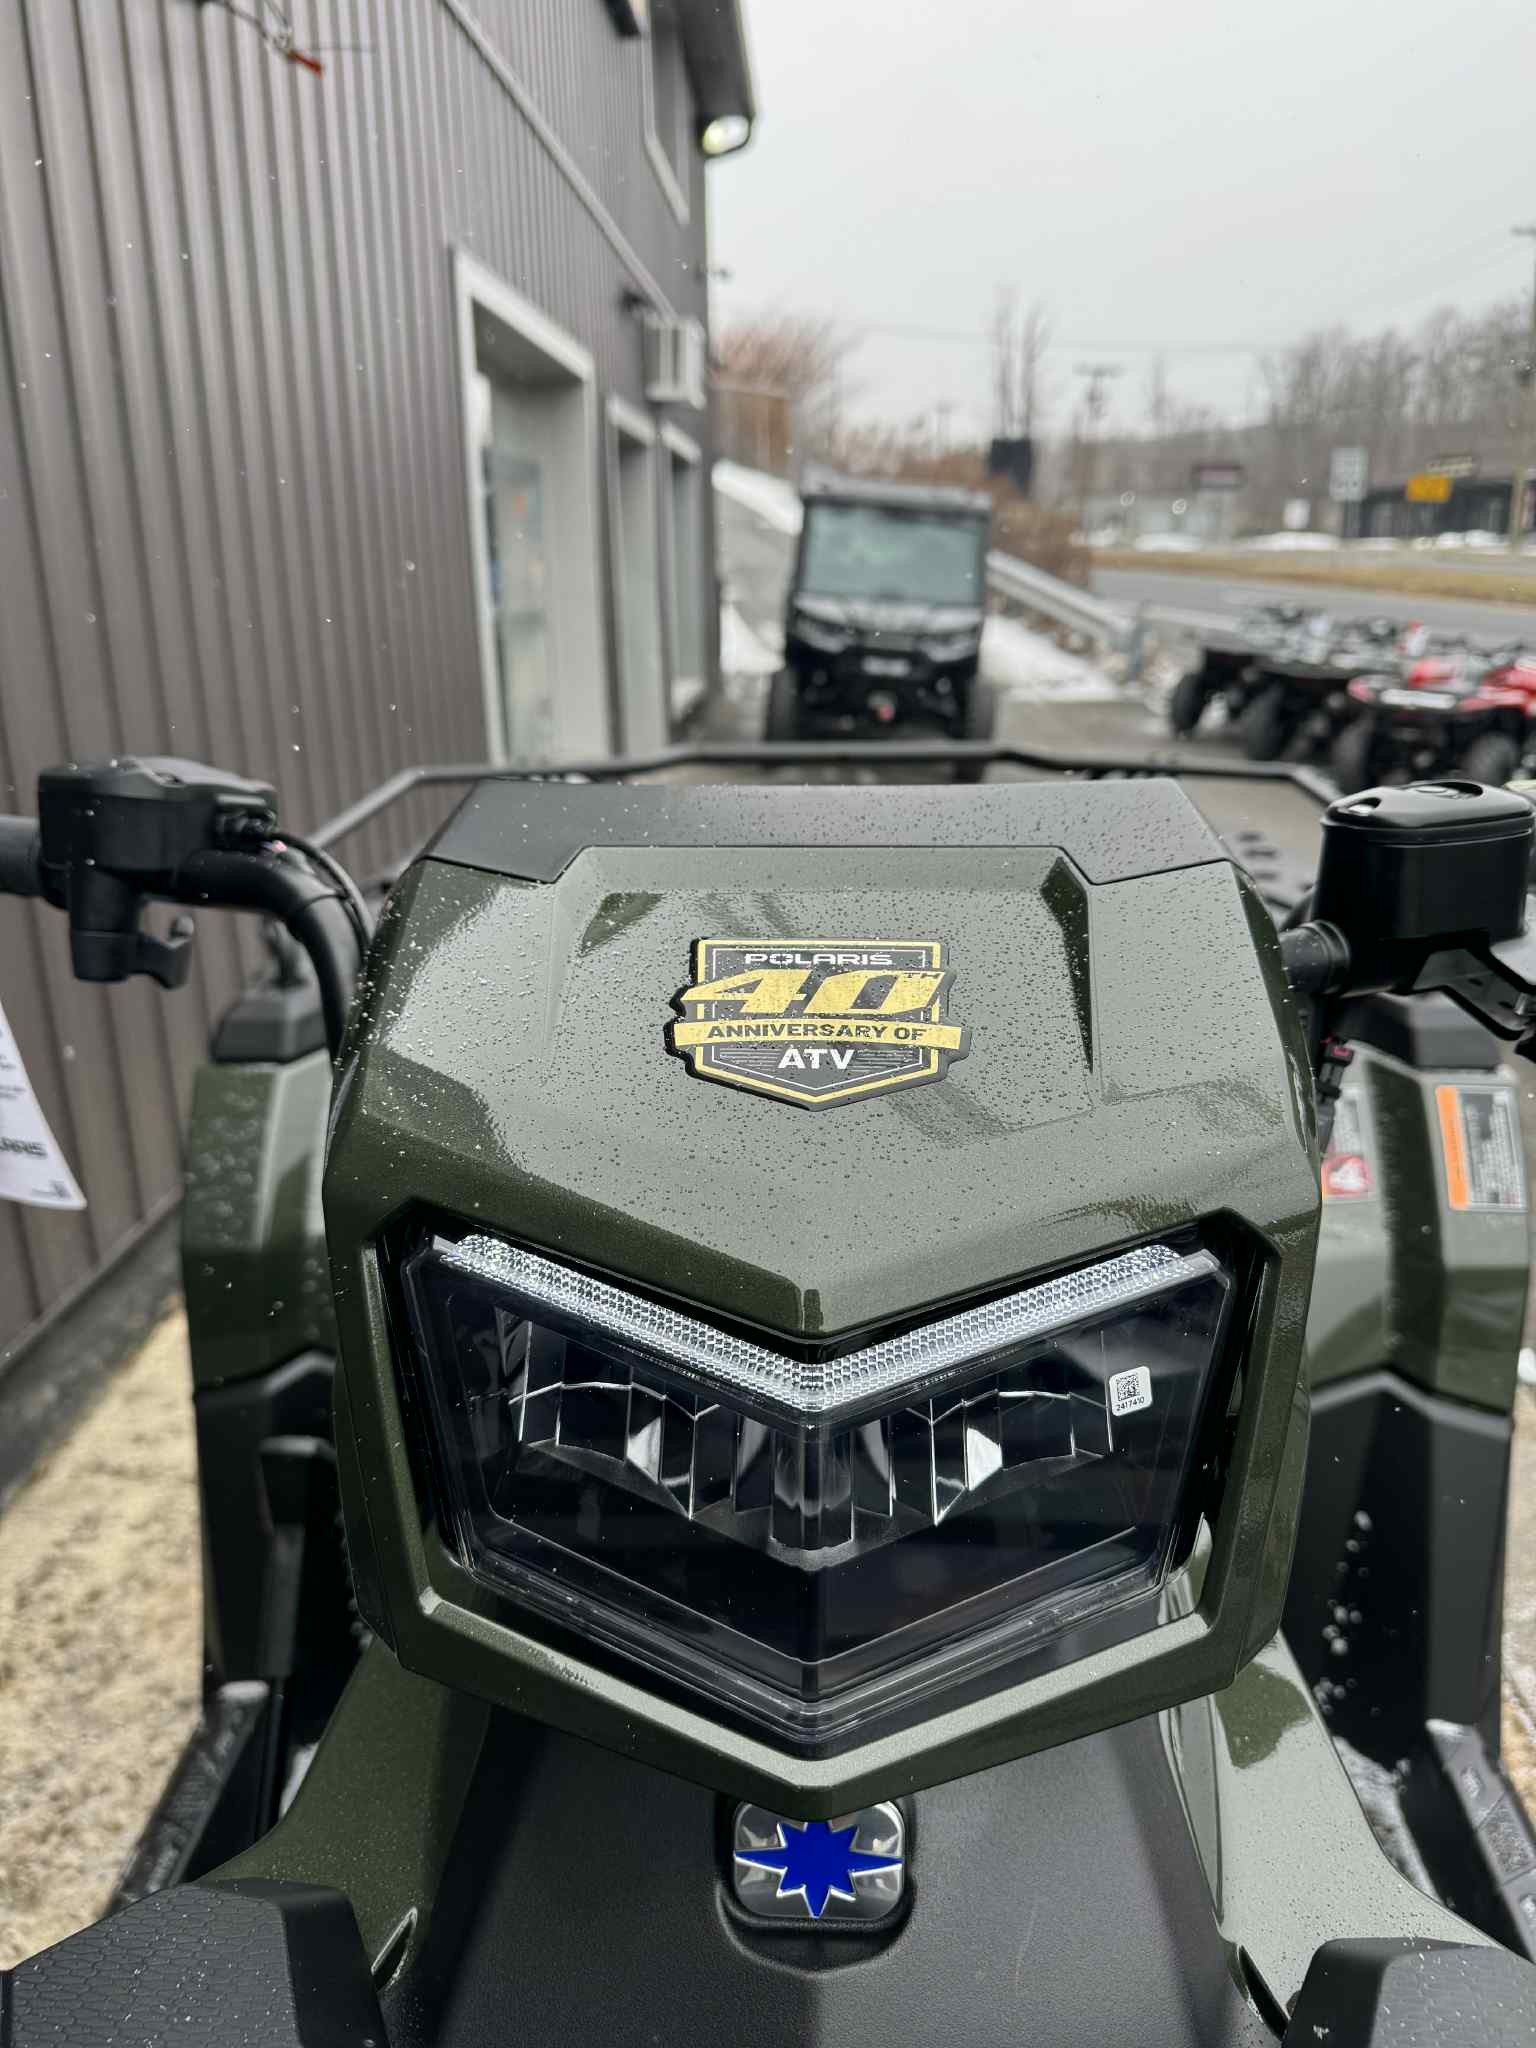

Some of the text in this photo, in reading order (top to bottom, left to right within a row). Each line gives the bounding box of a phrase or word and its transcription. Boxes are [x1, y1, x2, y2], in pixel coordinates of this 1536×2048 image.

[744, 952, 893, 965] POLARIS
[707, 1023, 928, 1041] ANNIVERSARY OF
[777, 1048, 855, 1070] ATV
